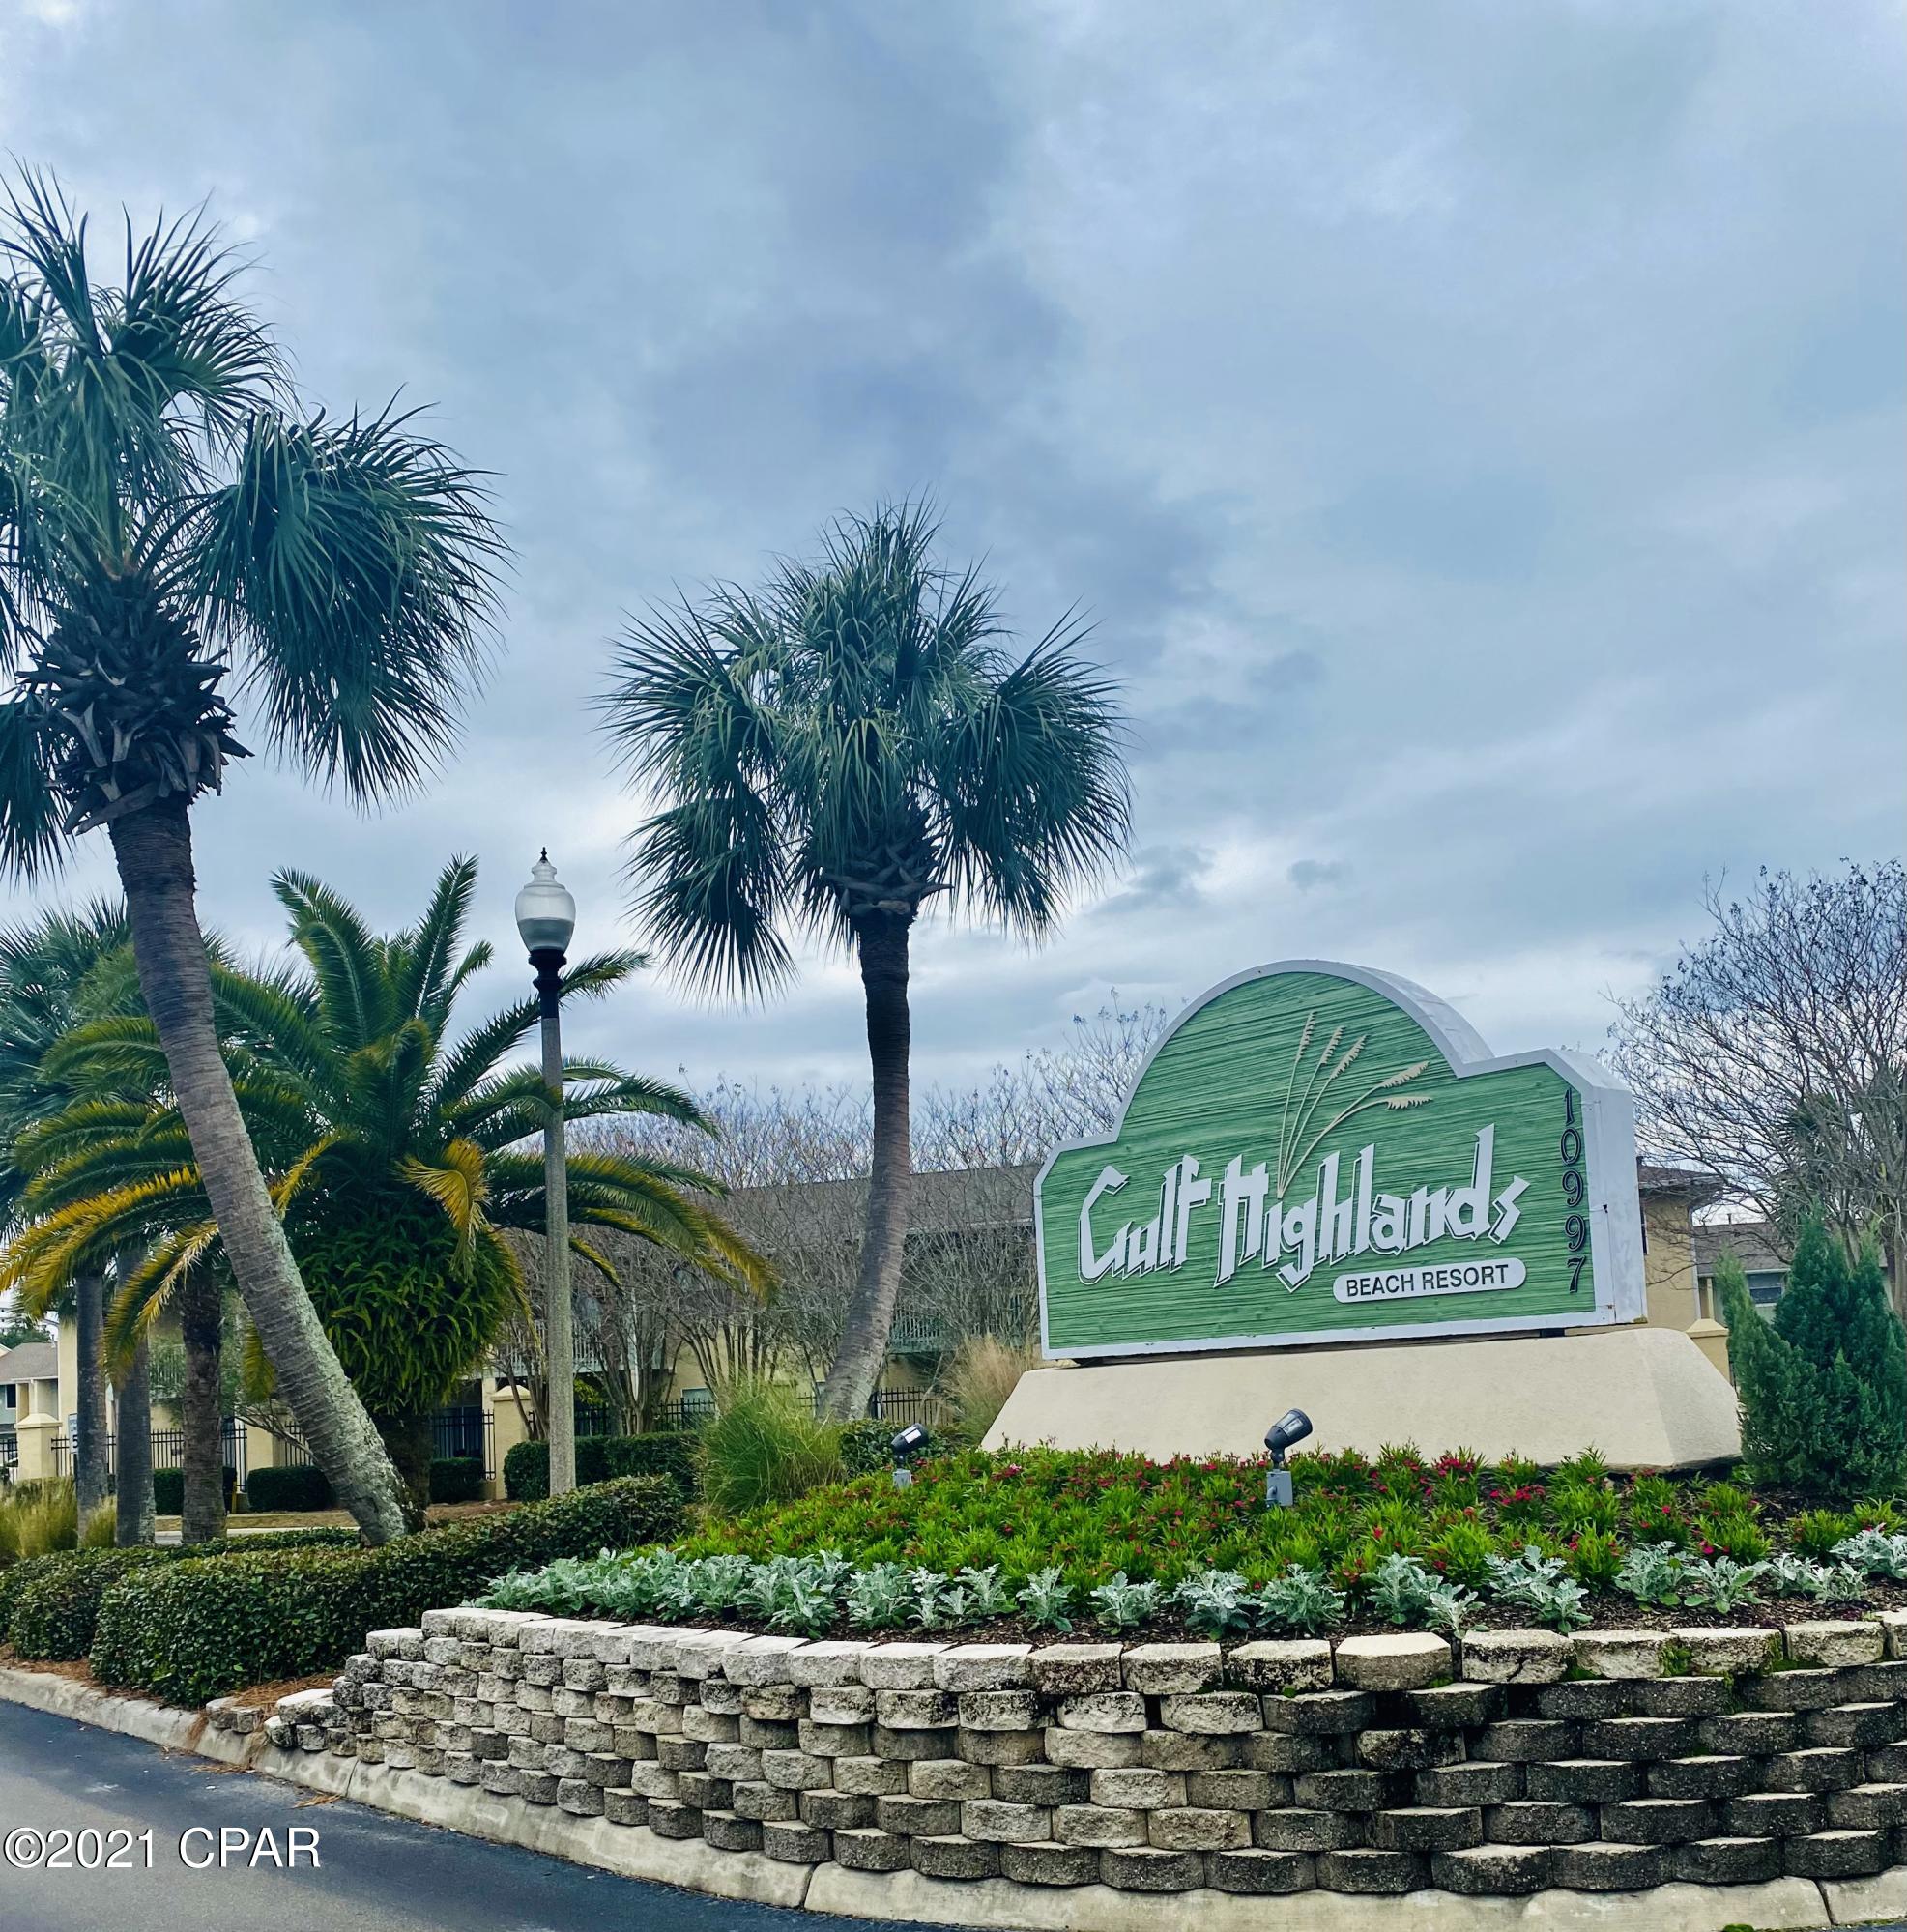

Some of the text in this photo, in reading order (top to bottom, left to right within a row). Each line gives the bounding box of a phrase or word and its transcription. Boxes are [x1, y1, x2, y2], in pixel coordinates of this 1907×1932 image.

[1078, 1123, 1531, 1293] Gulf Highlands
[1559, 1088, 1587, 1294] 10997
[1346, 1264, 1509, 1297] BEACH RESORT
